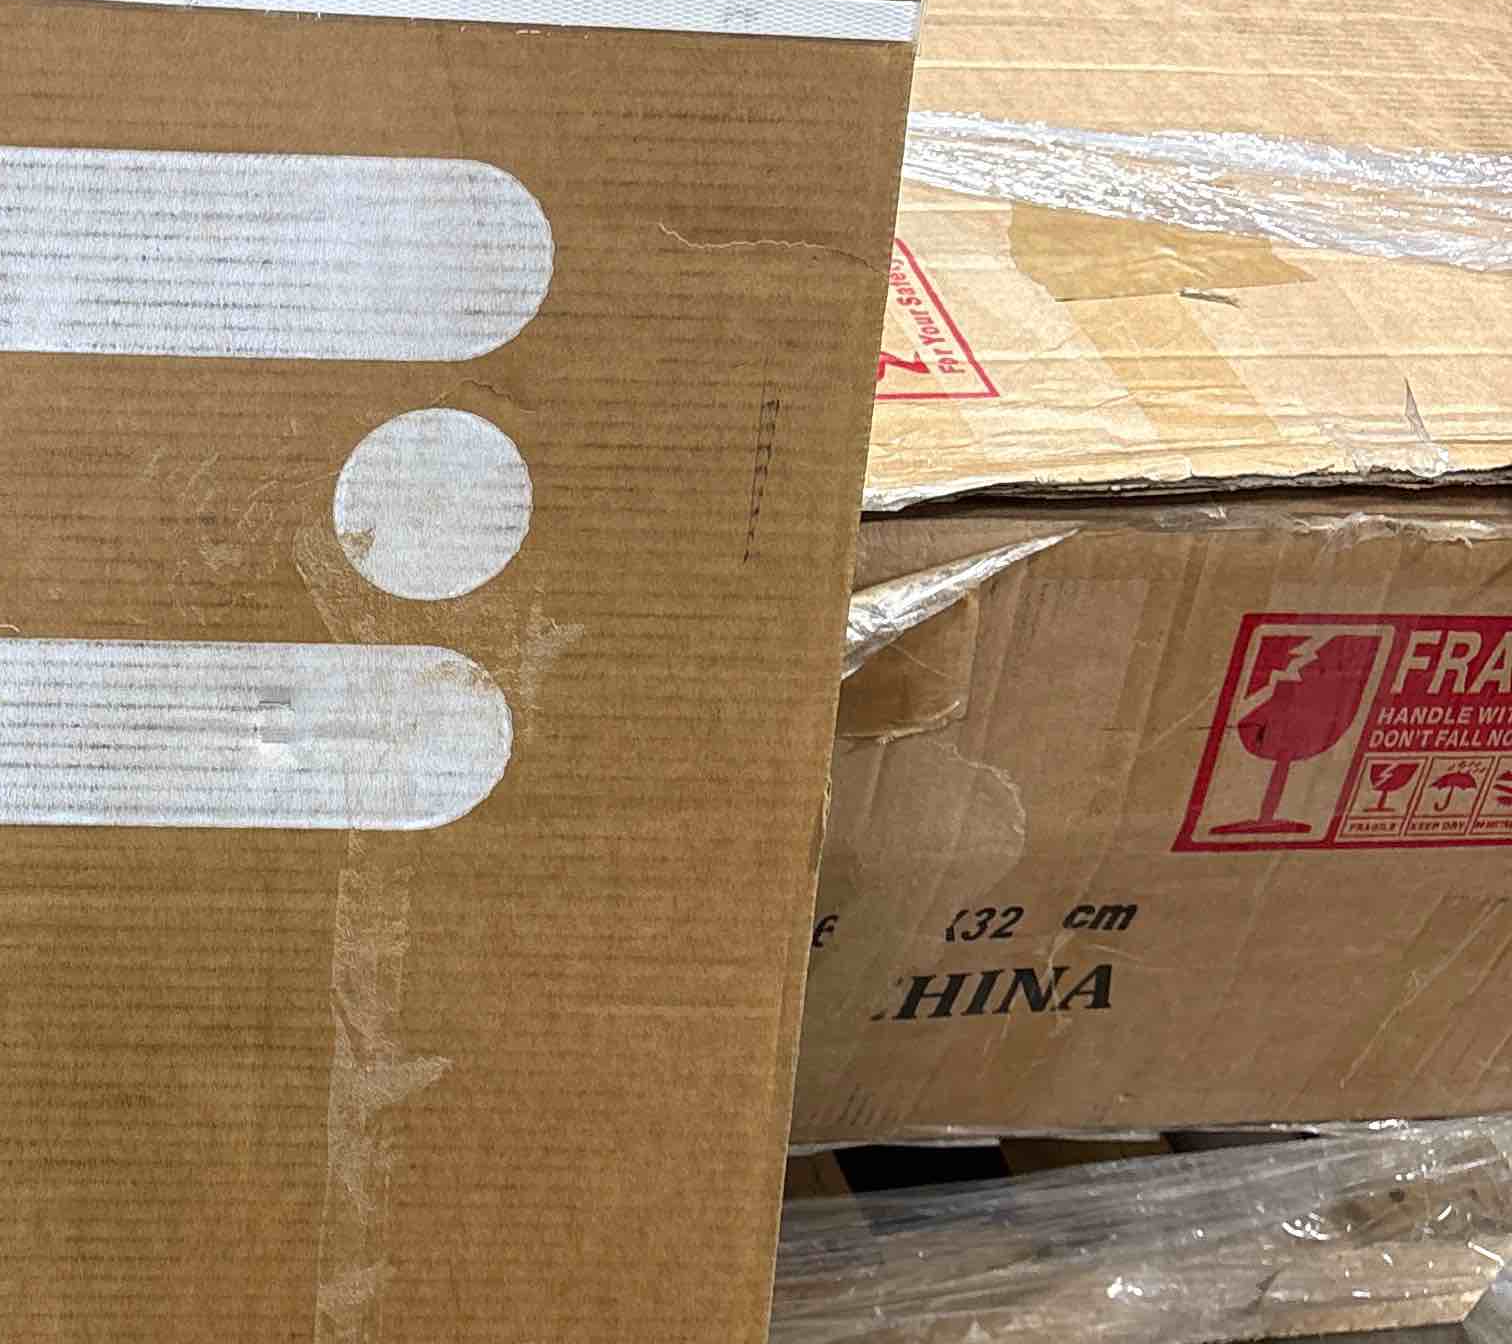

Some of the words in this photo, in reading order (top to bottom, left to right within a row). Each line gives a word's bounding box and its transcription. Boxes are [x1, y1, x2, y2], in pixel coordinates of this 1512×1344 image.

[909, 309, 946, 346] Your
[1390, 630, 1512, 695] FRA
[1377, 707, 1474, 725] HANDLE
[1368, 730, 1434, 748] DON'T
[1435, 730, 1481, 747] FALL
[1061, 904, 1137, 932] cm
[870, 963, 1113, 1022] HINA
